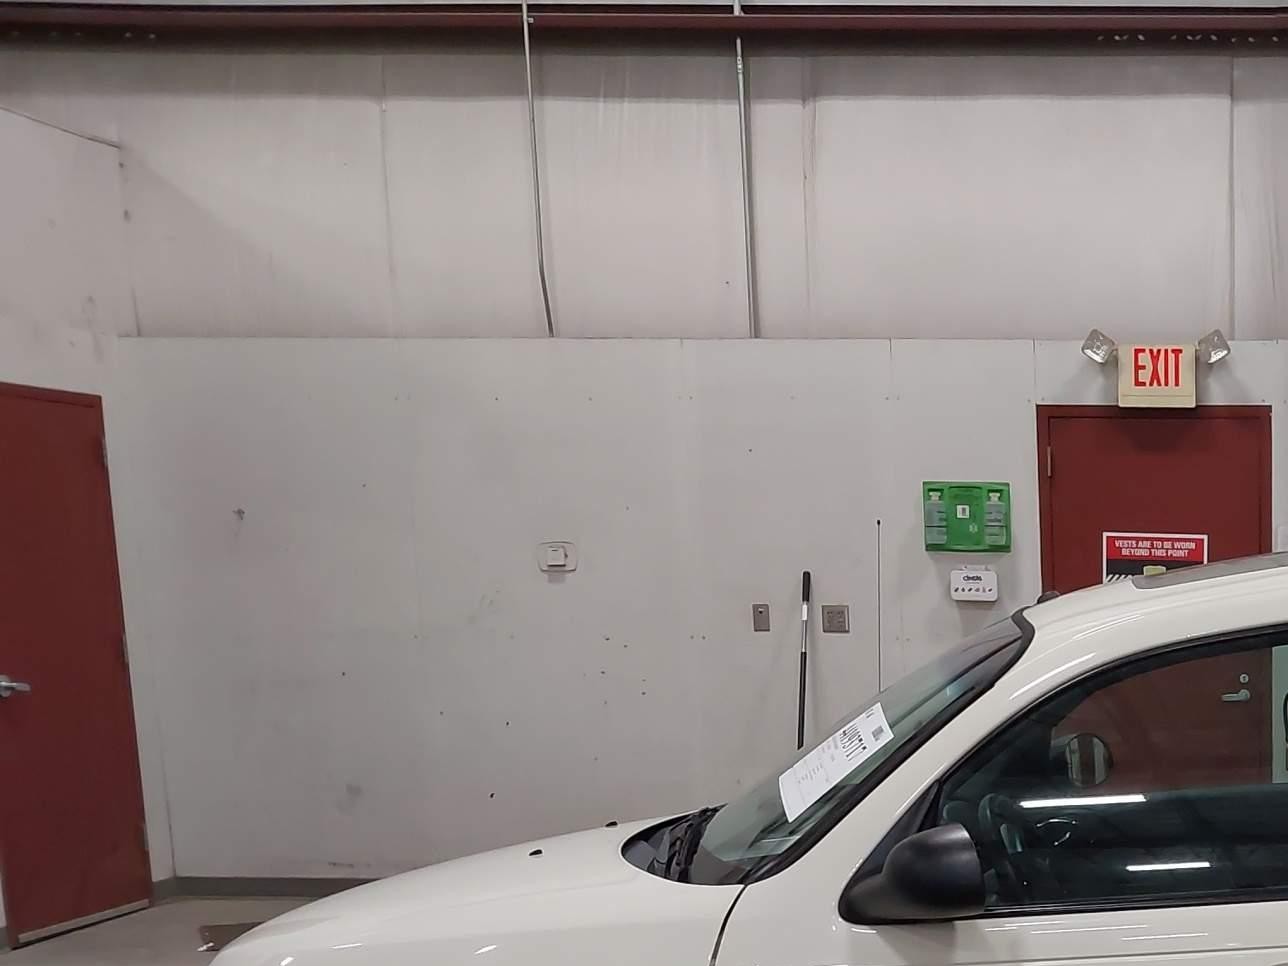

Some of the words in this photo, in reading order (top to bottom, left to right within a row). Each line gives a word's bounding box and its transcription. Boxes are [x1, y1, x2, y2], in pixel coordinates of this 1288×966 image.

[1134, 348, 1183, 387] EXIT
[1115, 540, 1137, 548] VESTS
[1138, 540, 1152, 548] ARE
[1163, 541, 1173, 549] BE
[1174, 541, 1196, 550] WORN
[1121, 548, 1150, 556] BEYOND
[1168, 549, 1189, 557] POINT
